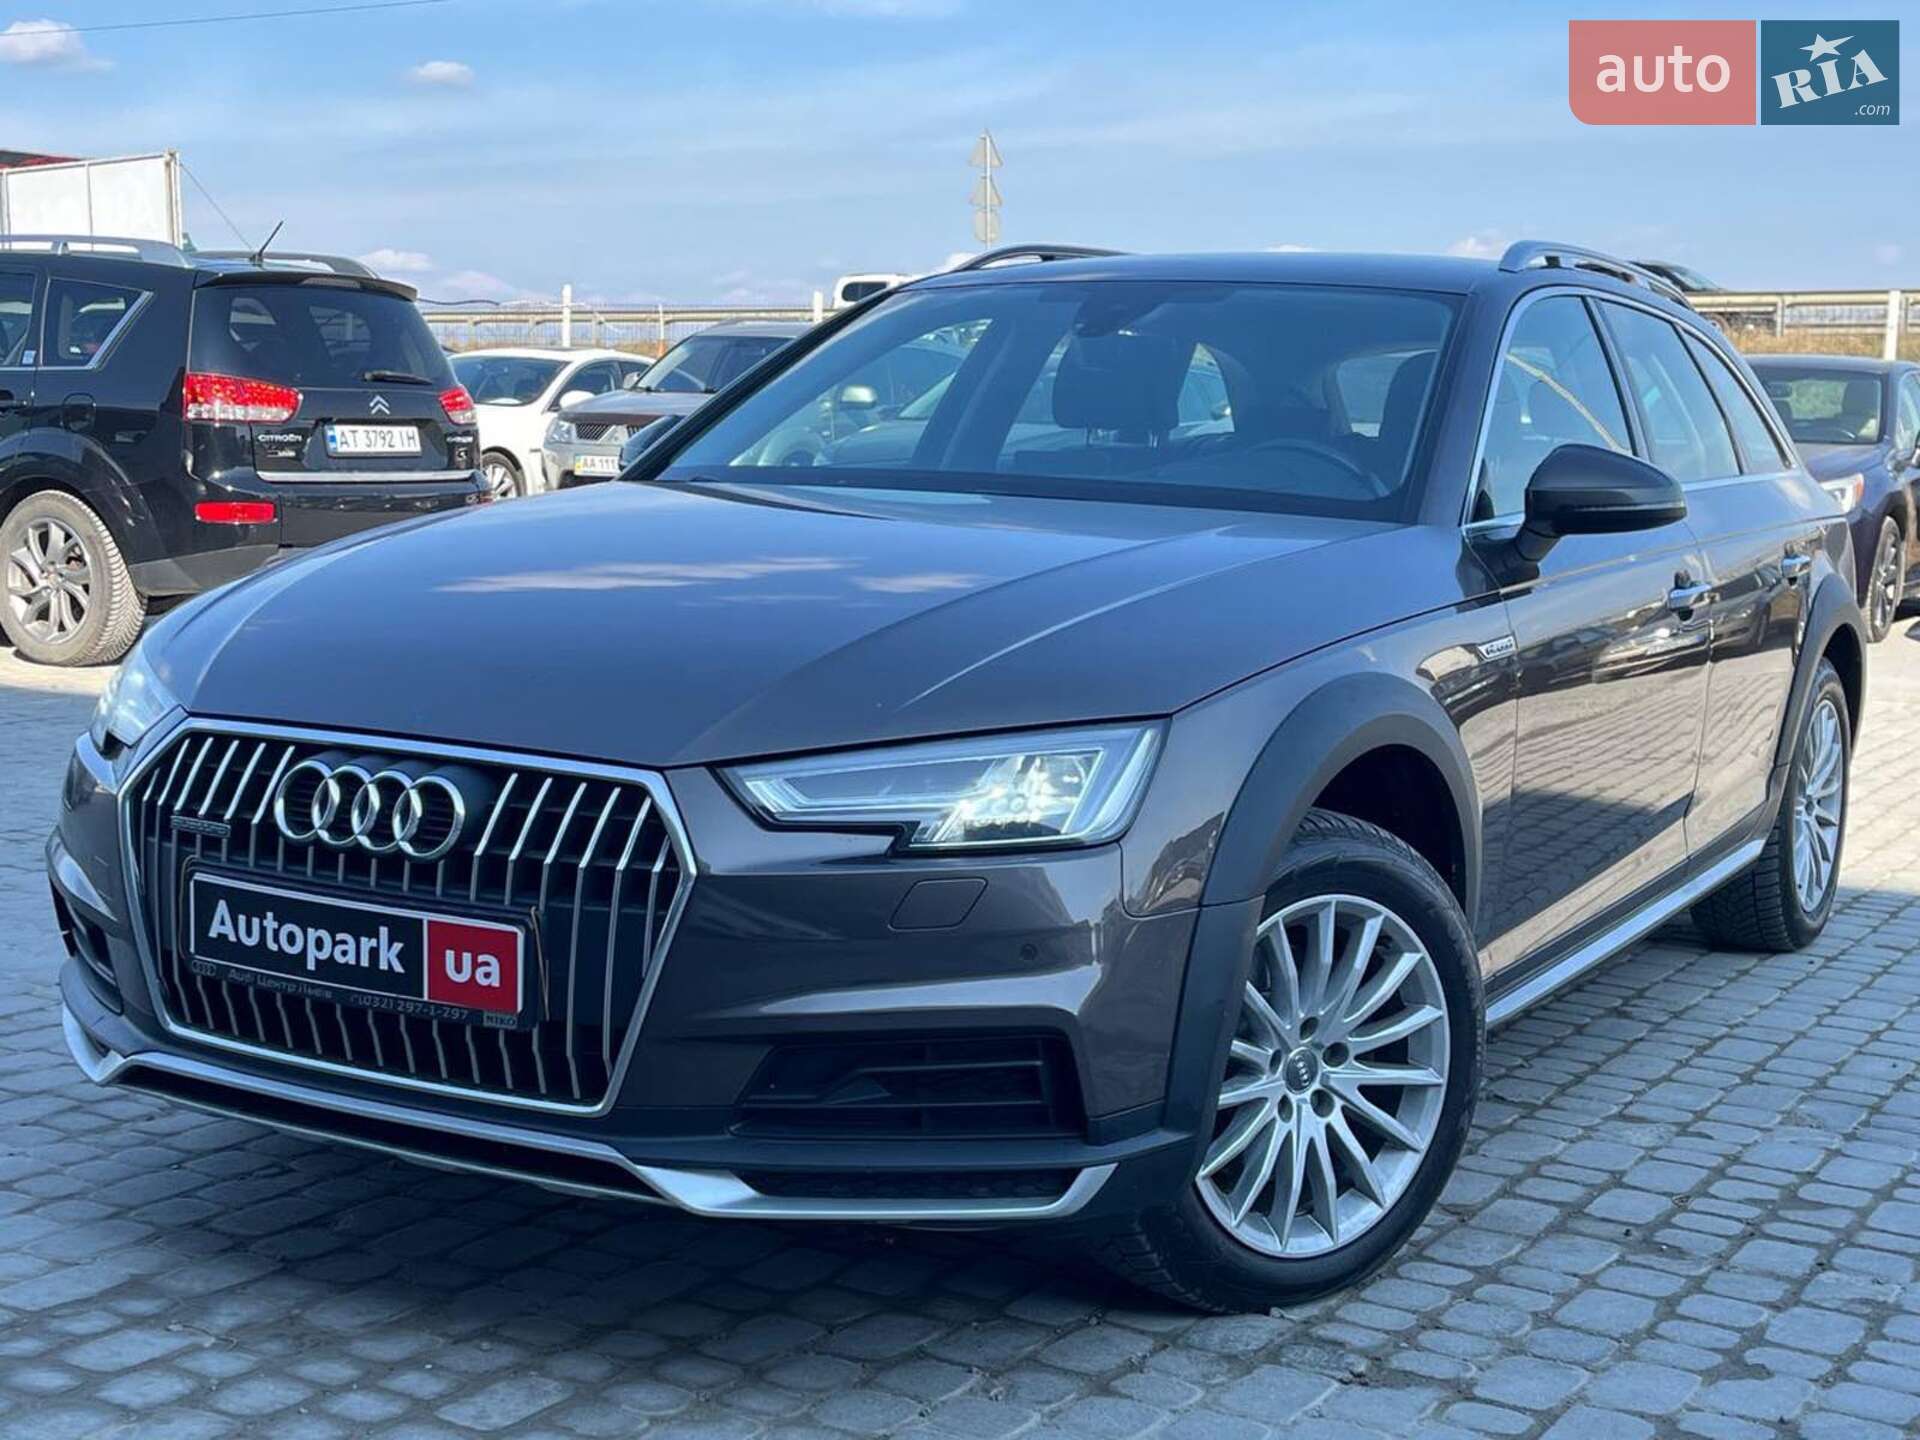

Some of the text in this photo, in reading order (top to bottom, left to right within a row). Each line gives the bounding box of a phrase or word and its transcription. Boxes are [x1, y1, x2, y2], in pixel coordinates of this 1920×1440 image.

[340, 429, 417, 448] AT 3792 IH
[208, 899, 405, 974] Autopark
[444, 947, 501, 988] ua
